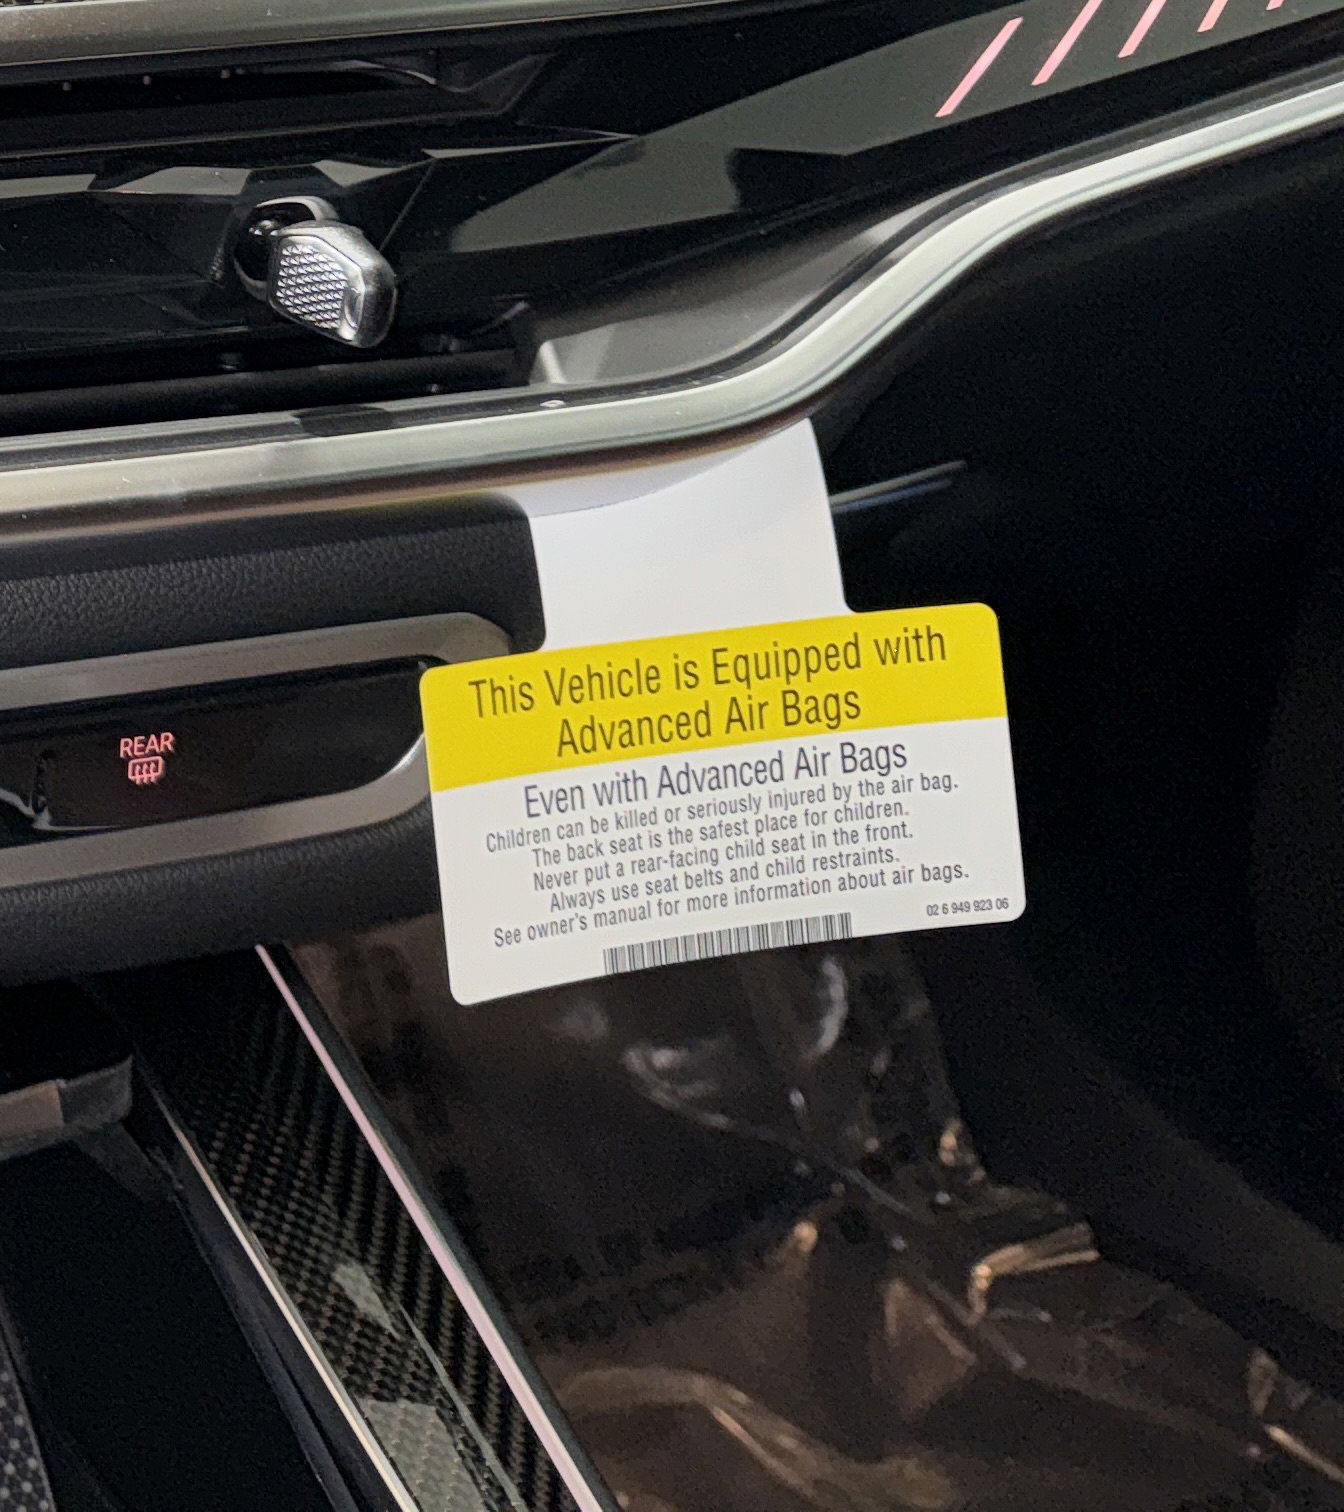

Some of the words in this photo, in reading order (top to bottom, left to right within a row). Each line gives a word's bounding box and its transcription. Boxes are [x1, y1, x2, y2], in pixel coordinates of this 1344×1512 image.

[468, 675, 534, 718] This
[544, 658, 661, 706] Vehicle
[673, 653, 699, 690] is
[712, 632, 862, 689] Equipped
[873, 625, 946, 666] with
[119, 732, 175, 759] REAR
[557, 700, 712, 757] Advanced
[724, 694, 768, 734] Air
[781, 689, 862, 730] Bags
[486, 826, 551, 853] Children
[556, 821, 584, 840] can
[590, 815, 609, 835] be
[615, 806, 658, 831] killed
[664, 806, 681, 823] or
[687, 791, 762, 819] seriously
[768, 784, 826, 811] injured
[833, 782, 852, 803] by
[858, 780, 885, 798] the
[891, 776, 914, 794] air
[920, 772, 959, 793] bag.
[524, 784, 585, 819] Even
[594, 769, 647, 806] with
[657, 750, 784, 799] Advanced
[793, 745, 831, 780] Air
[840, 741, 908, 776] Bags
[532, 847, 561, 868] The
[567, 839, 604, 862] back
[609, 836, 642, 855] seat
[648, 831, 662, 849] is
[667, 826, 693, 845] the
[699, 818, 749, 841] safest
[755, 812, 797, 836] place
[804, 808, 827, 827] for
[834, 800, 910, 824] children.
[533, 871, 578, 891] Never
[584, 862, 611, 886] put
[616, 862, 625, 877] a
[630, 847, 719, 876] rear-facing
[725, 834, 763, 861] child
[771, 836, 806, 855] seat
[811, 831, 827, 848] in
[833, 829, 859, 846] the
[865, 821, 913, 840] front.
[494, 927, 521, 948] See
[527, 912, 588, 941] owner's
[594, 901, 652, 928] manual
[657, 899, 680, 918] for
[687, 893, 728, 913] more
[734, 876, 831, 905] information
[838, 870, 886, 892] about
[892, 867, 914, 885] air
[920, 863, 970, 884] bags.
[550, 887, 605, 913] Always
[611, 883, 639, 902] use
[645, 877, 679, 896] seat
[684, 867, 723, 889] belts
[729, 864, 759, 886] and
[766, 855, 805, 877] child
[812, 846, 900, 872] restraints.
[926, 904, 939, 916] 02
[942, 903, 949, 914] 6
[951, 901, 971, 913] 949
[973, 899, 993, 911] 923
